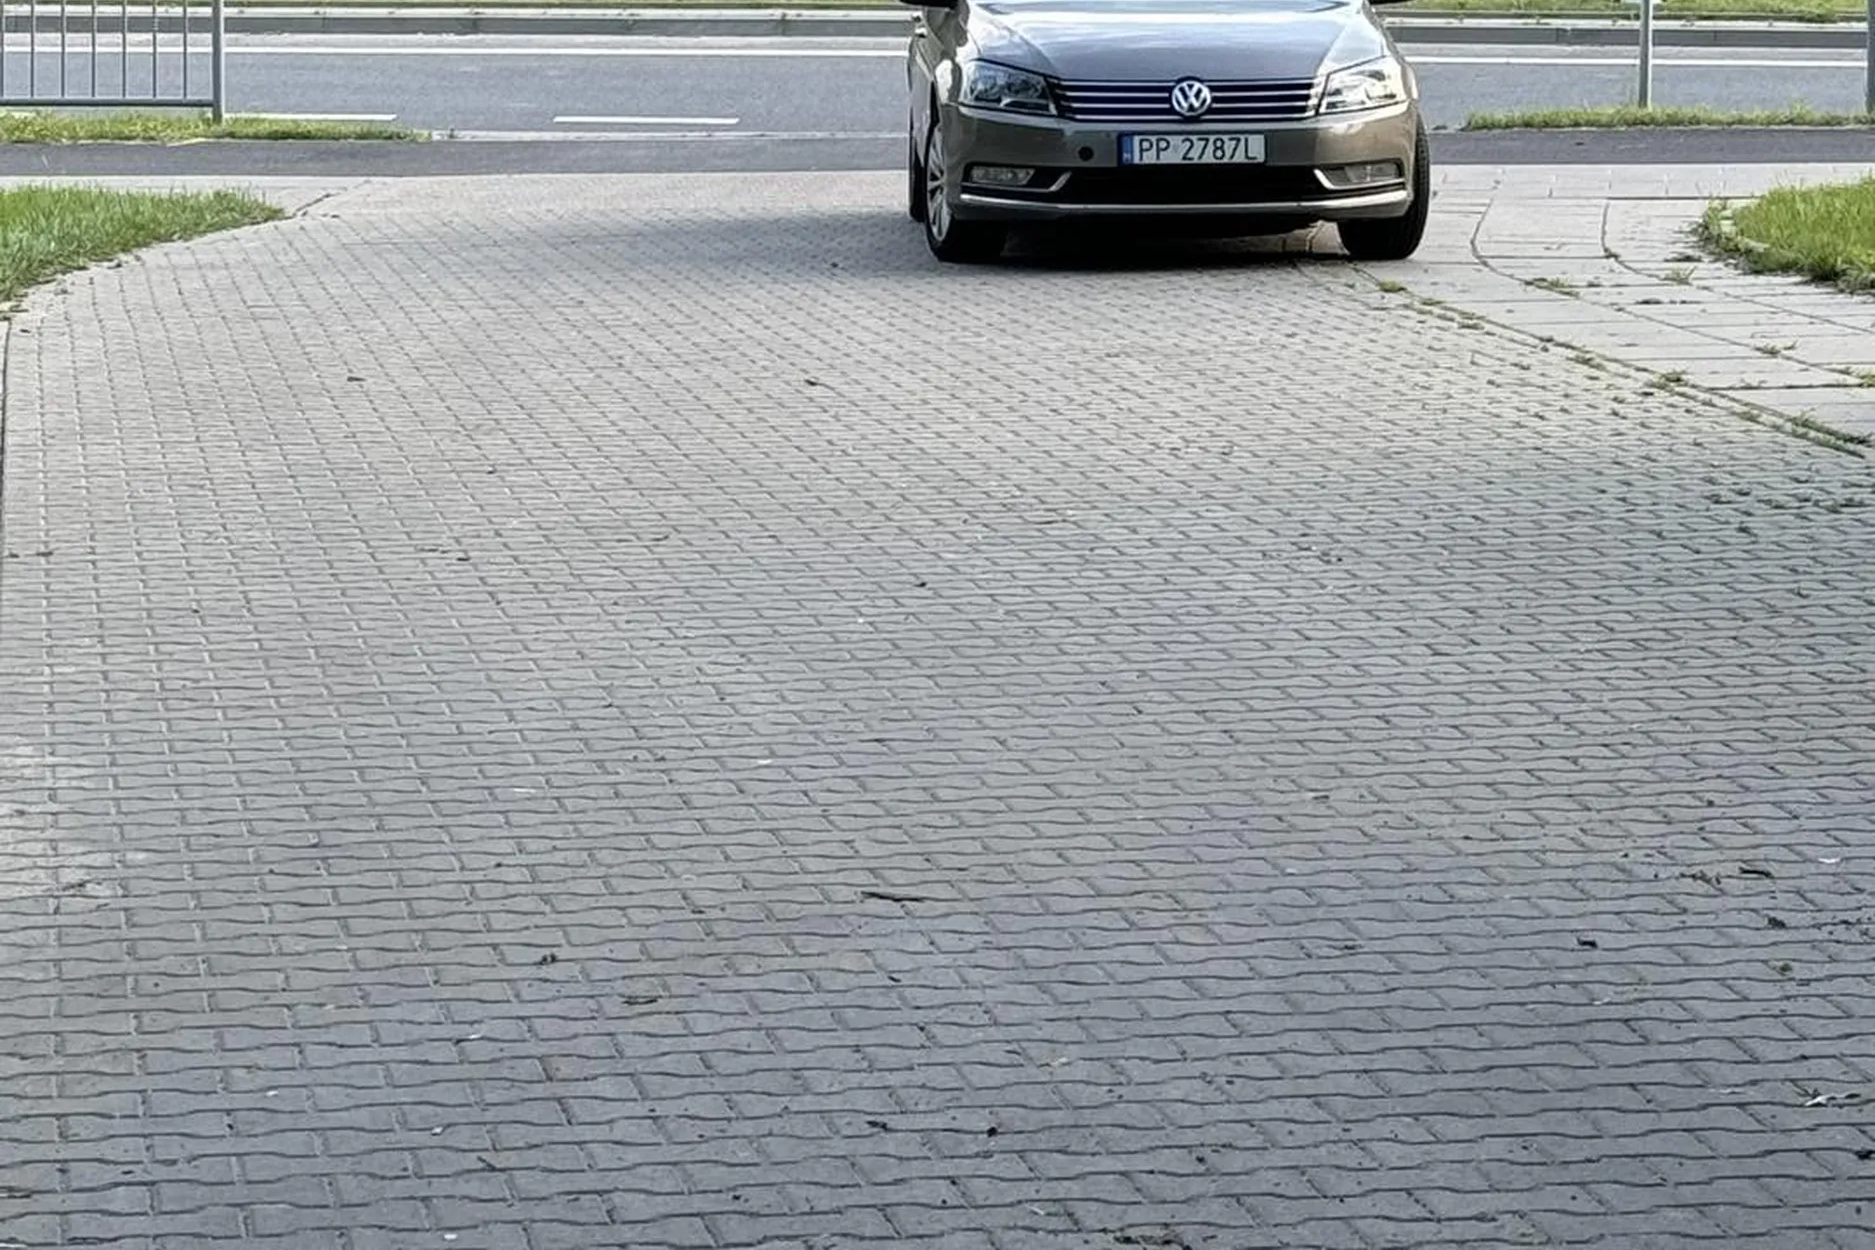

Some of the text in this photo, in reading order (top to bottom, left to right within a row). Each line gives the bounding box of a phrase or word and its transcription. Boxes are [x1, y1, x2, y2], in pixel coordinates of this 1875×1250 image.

[1173, 81, 1210, 115] VW
[1139, 137, 1170, 161] PP
[1181, 137, 1257, 161] 2787L
